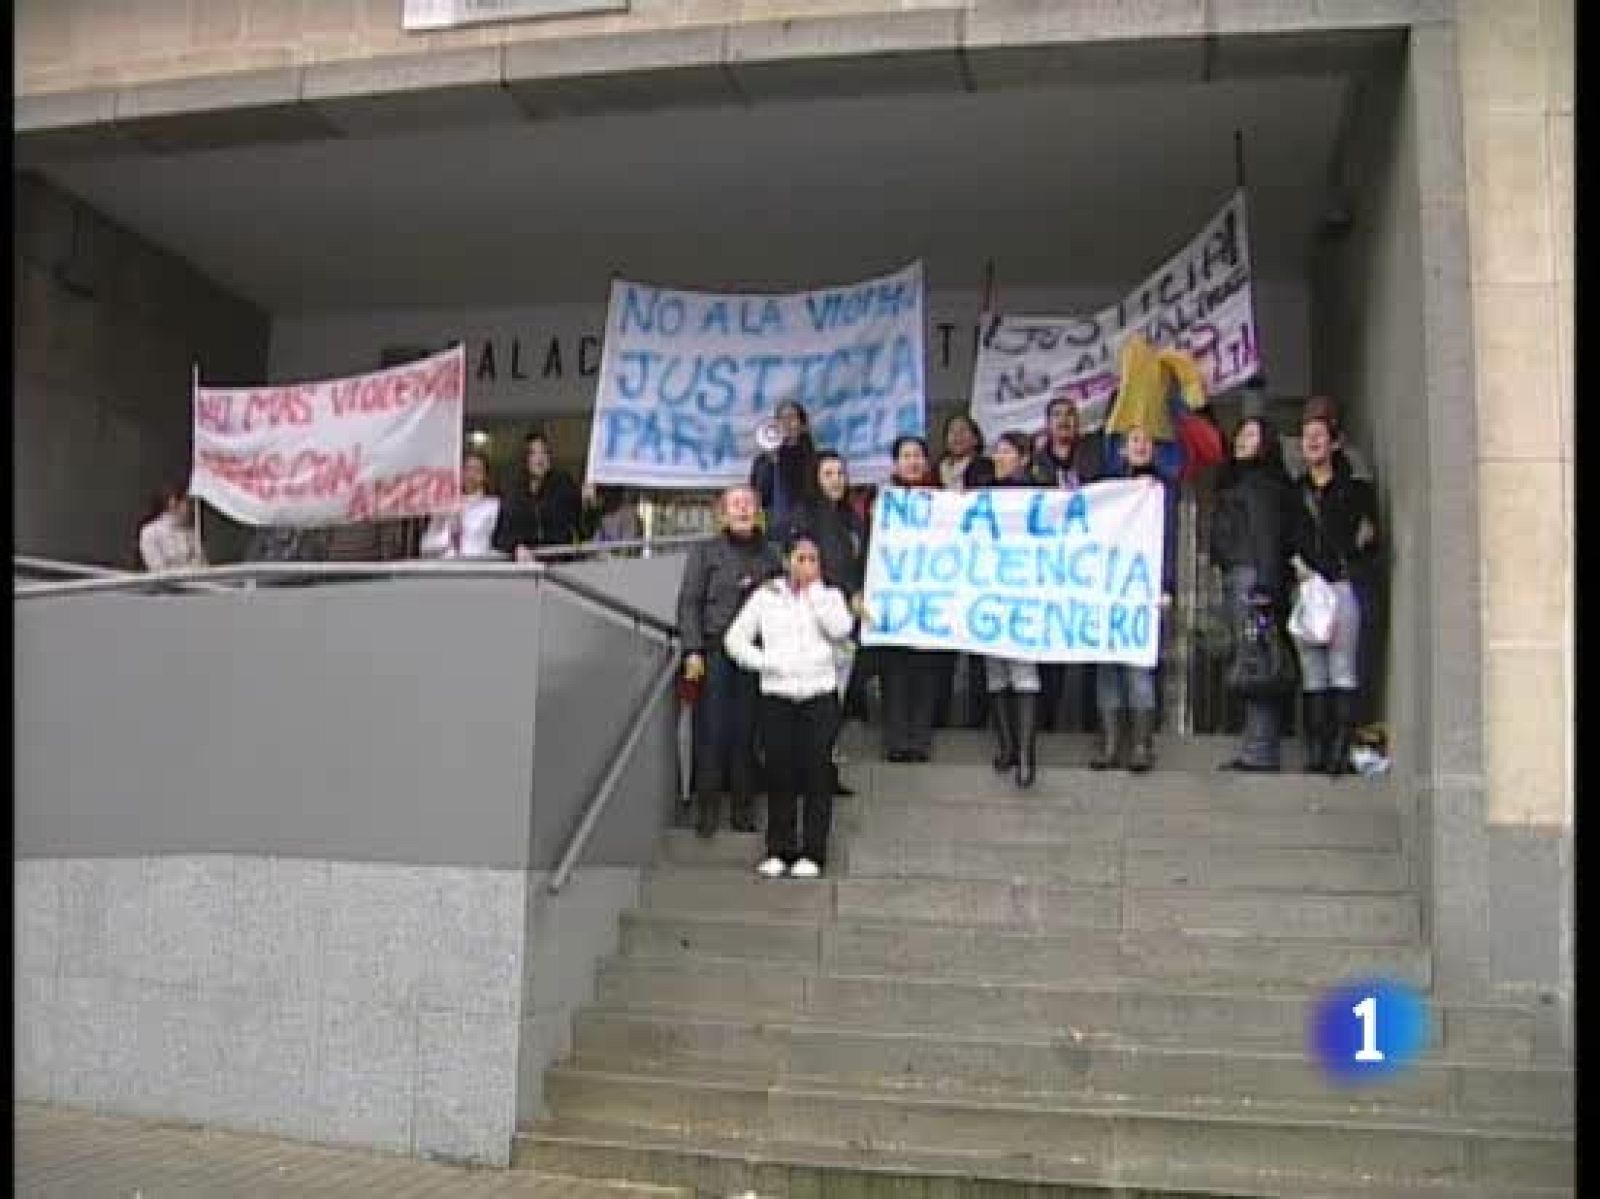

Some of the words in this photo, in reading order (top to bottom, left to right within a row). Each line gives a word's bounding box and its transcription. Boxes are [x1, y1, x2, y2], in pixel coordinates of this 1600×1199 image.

[621, 287, 686, 335] NO
[702, 301, 730, 336] A
[739, 301, 787, 336] LA
[476, 334, 598, 381] ALAC
[616, 335, 920, 416] JUSTICIA
[603, 407, 740, 463] PARA
[881, 489, 932, 530] NO
[960, 489, 998, 539] A
[1026, 489, 1089, 537] LA
[880, 541, 1152, 602] VIOLENCIA
[871, 590, 950, 636] DE
[967, 592, 1149, 650] GENERO
